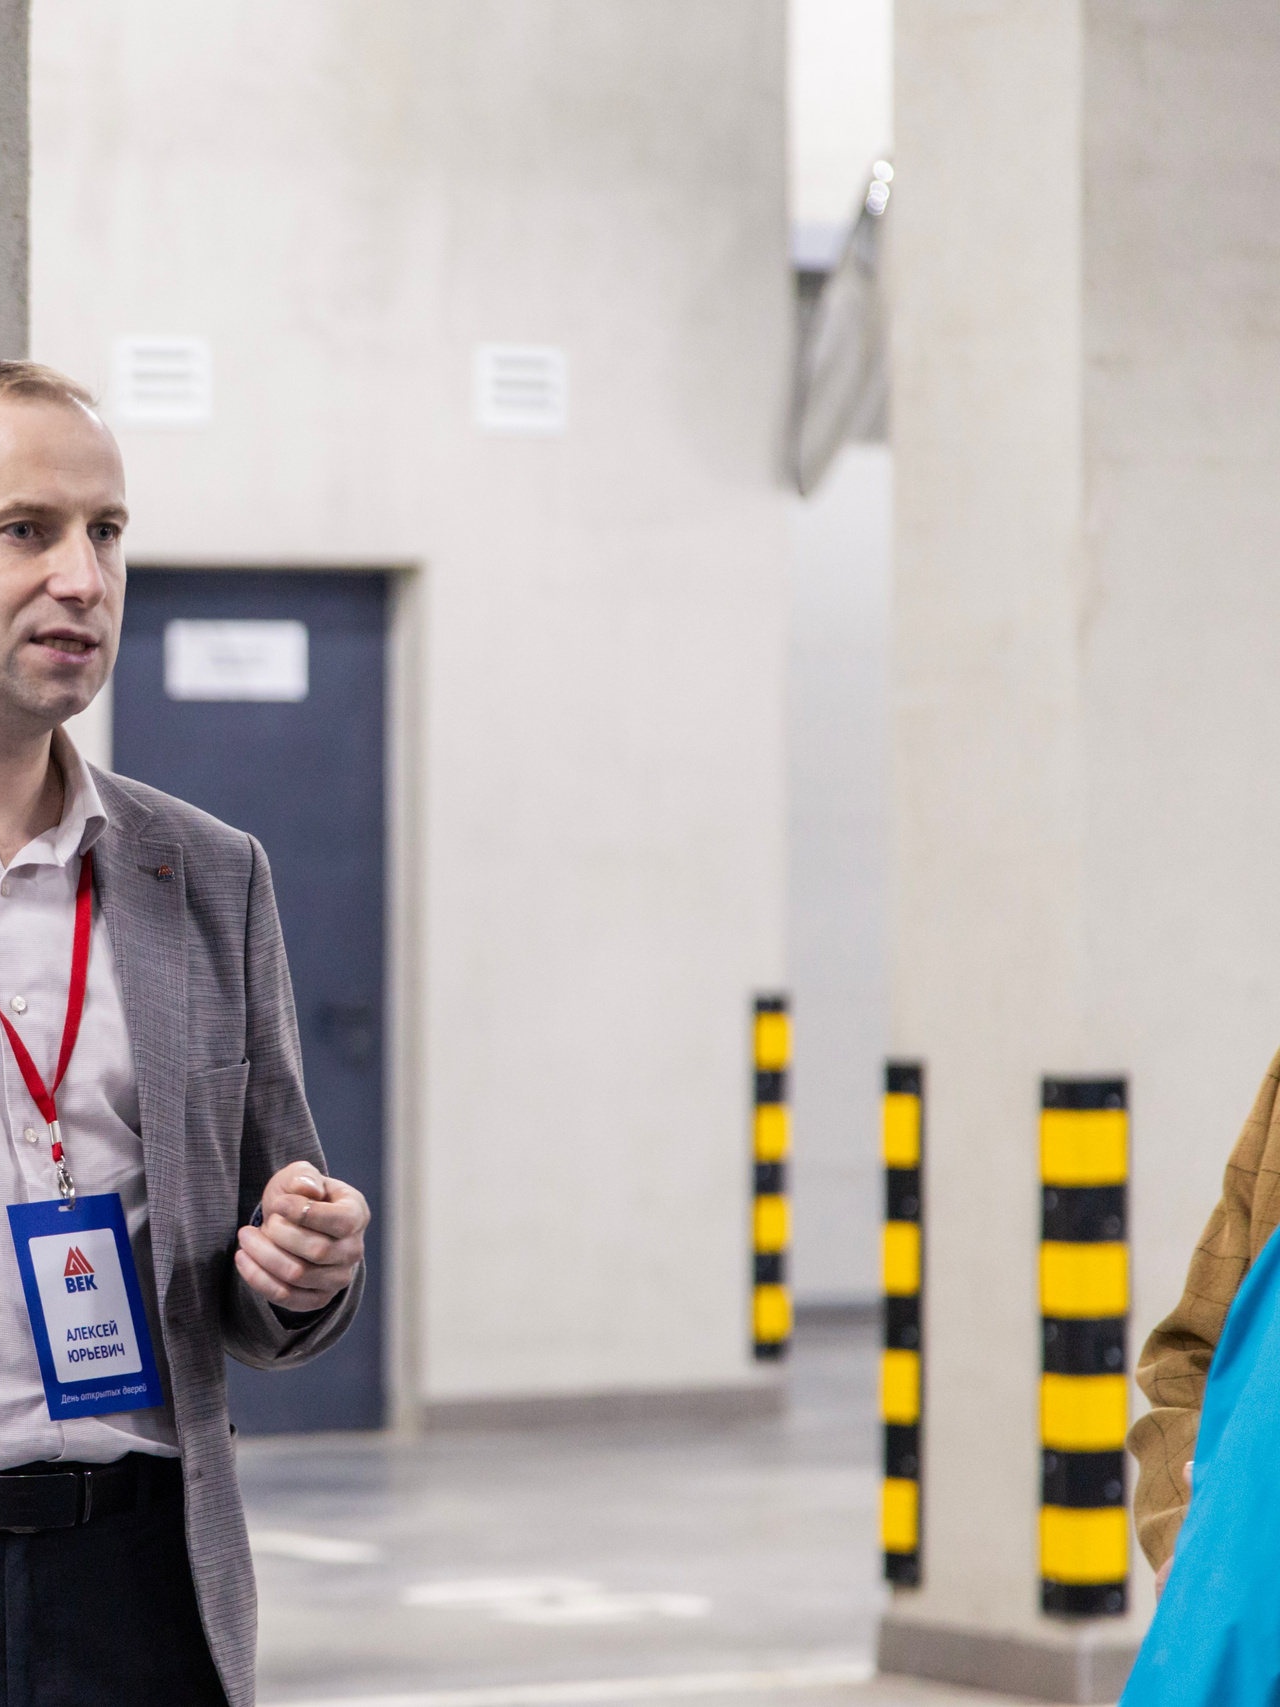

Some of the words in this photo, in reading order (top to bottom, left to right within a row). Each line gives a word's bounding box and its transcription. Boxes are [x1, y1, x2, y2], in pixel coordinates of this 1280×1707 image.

[65, 1274, 98, 1294] ВЕК
[66, 1320, 119, 1342] АЛЕКСЕЙ
[67, 1343, 126, 1363] ЮРЬЕВИЧ
[61, 1394, 79, 1405] День
[80, 1388, 122, 1401] открытых
[122, 1383, 148, 1396] дверей
